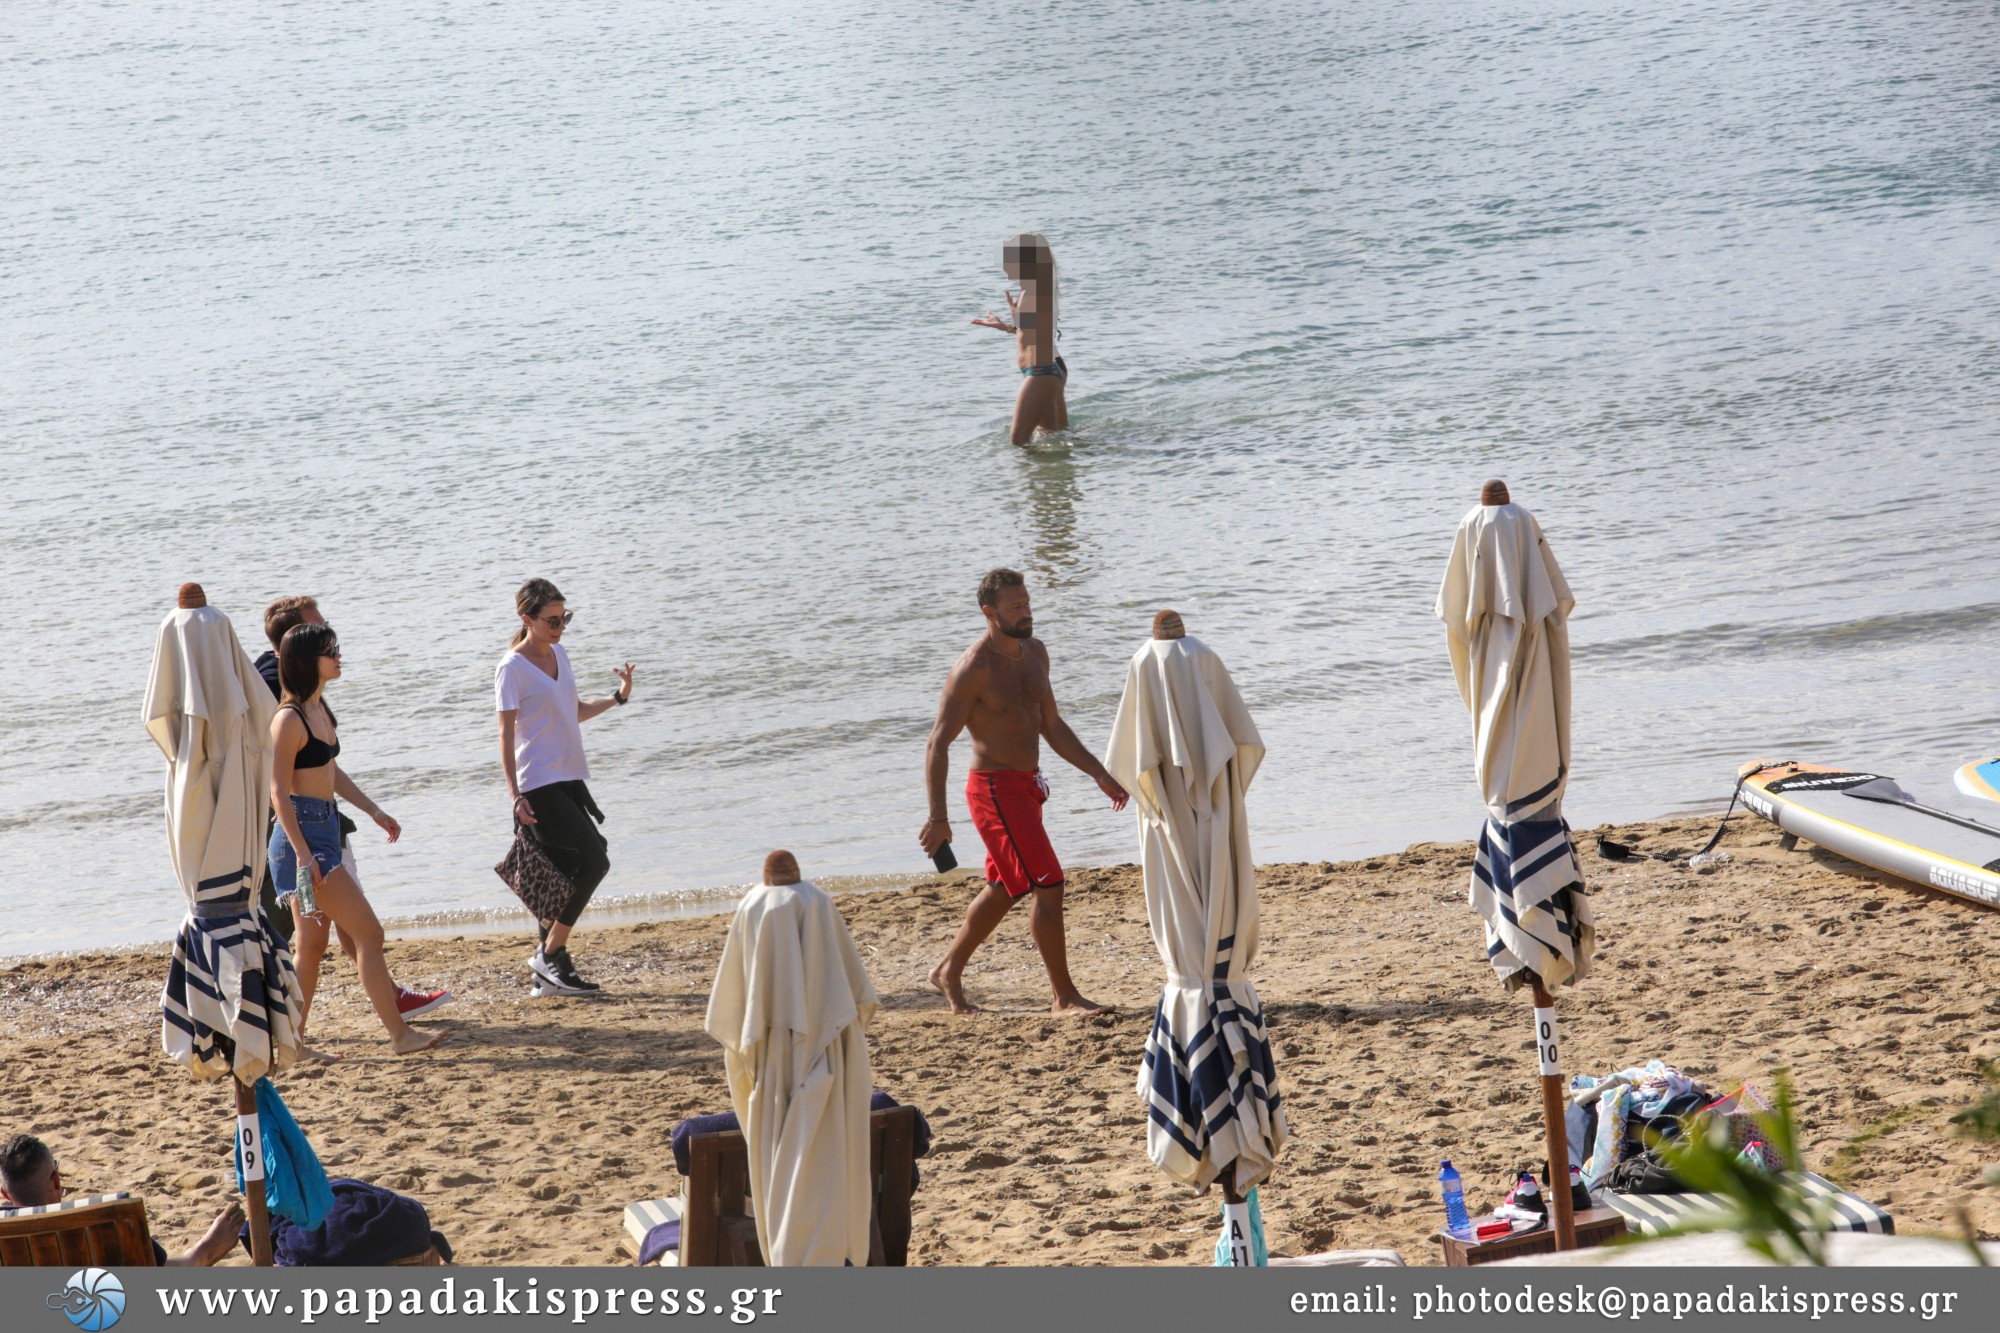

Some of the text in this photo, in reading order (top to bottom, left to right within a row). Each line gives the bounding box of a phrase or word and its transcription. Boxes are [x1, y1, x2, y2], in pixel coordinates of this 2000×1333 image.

[1929, 866, 1998, 902] AQUASUP
[1539, 1044, 1558, 1064] 10
[245, 1151, 255, 1170] 9
[1231, 1219, 1244, 1240] A
[1230, 1245, 1249, 1267] 41
